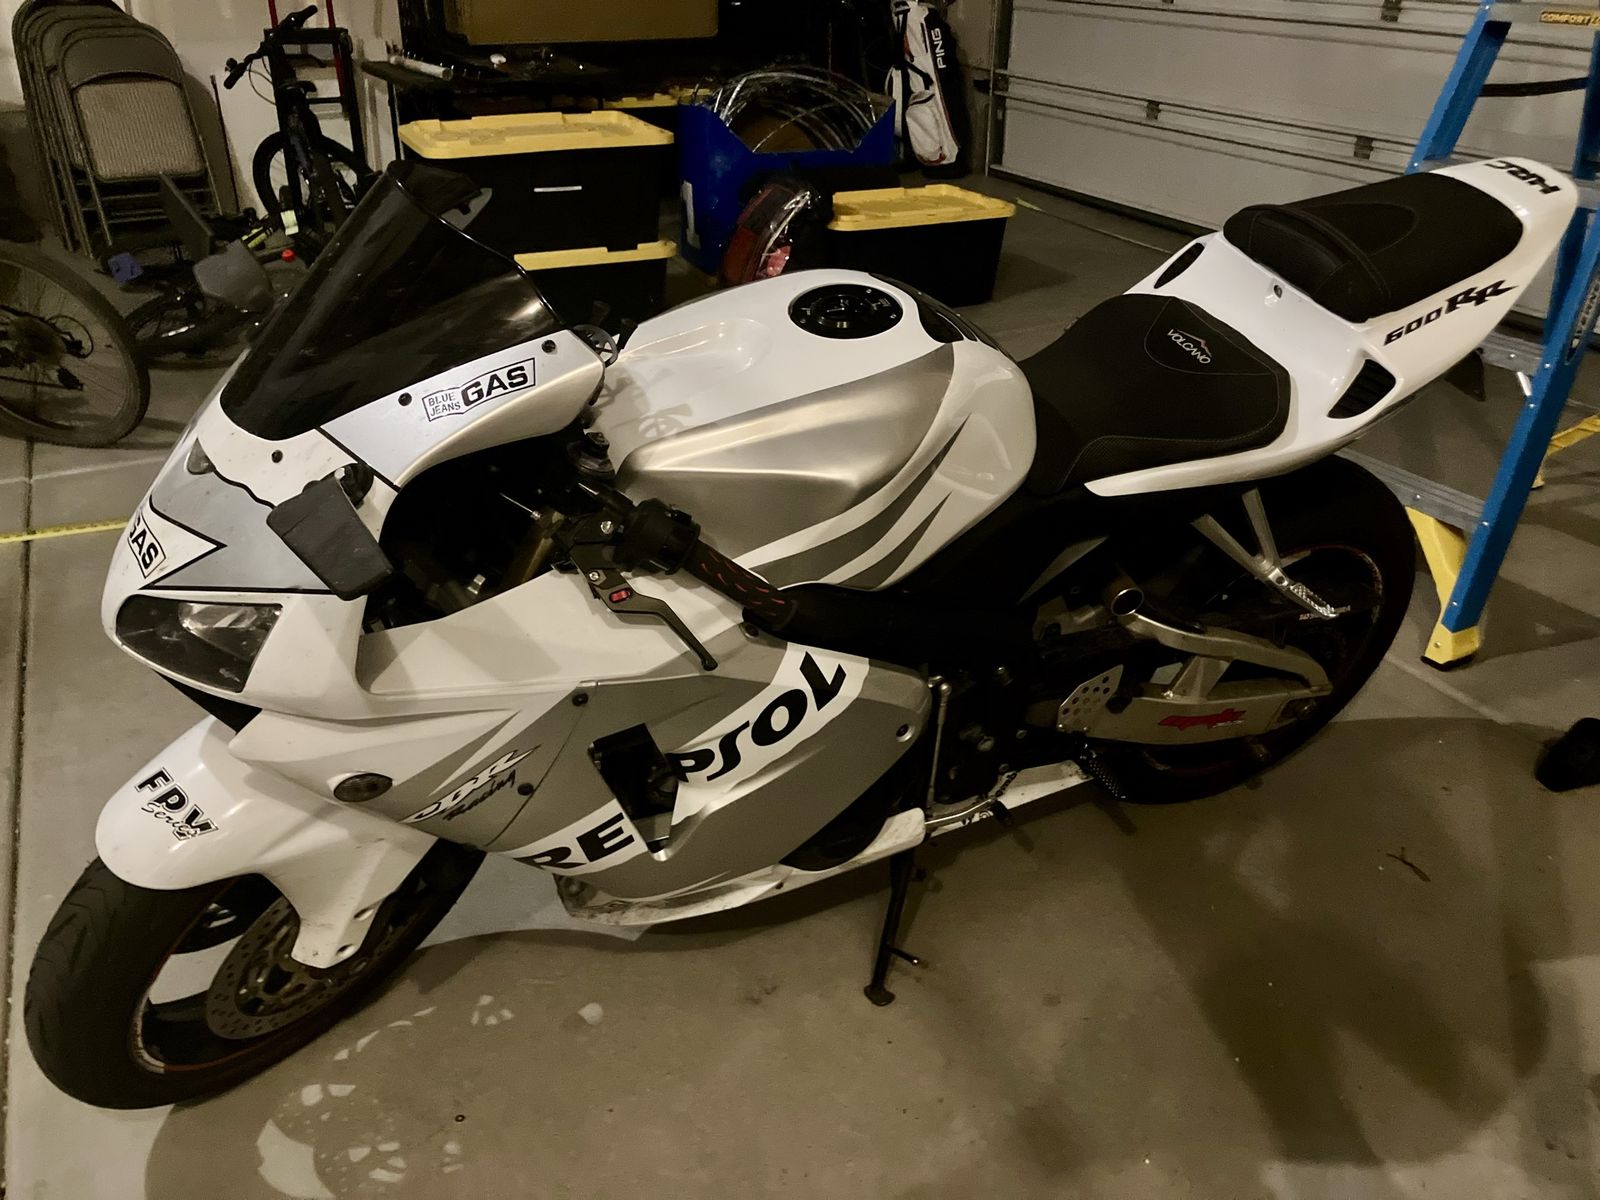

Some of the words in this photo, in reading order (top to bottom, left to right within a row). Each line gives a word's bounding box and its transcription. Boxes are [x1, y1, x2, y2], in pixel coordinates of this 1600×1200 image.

[931, 28, 947, 68] PING
[1484, 160, 1561, 194] HRC
[1383, 306, 1443, 346] 600
[1444, 280, 1518, 314] RR
[1167, 329, 1211, 364] VOLCANO
[428, 392, 456, 407] BLUE
[461, 366, 529, 407] GAS
[430, 401, 461, 417] JEANS
[134, 767, 219, 841] FPV
